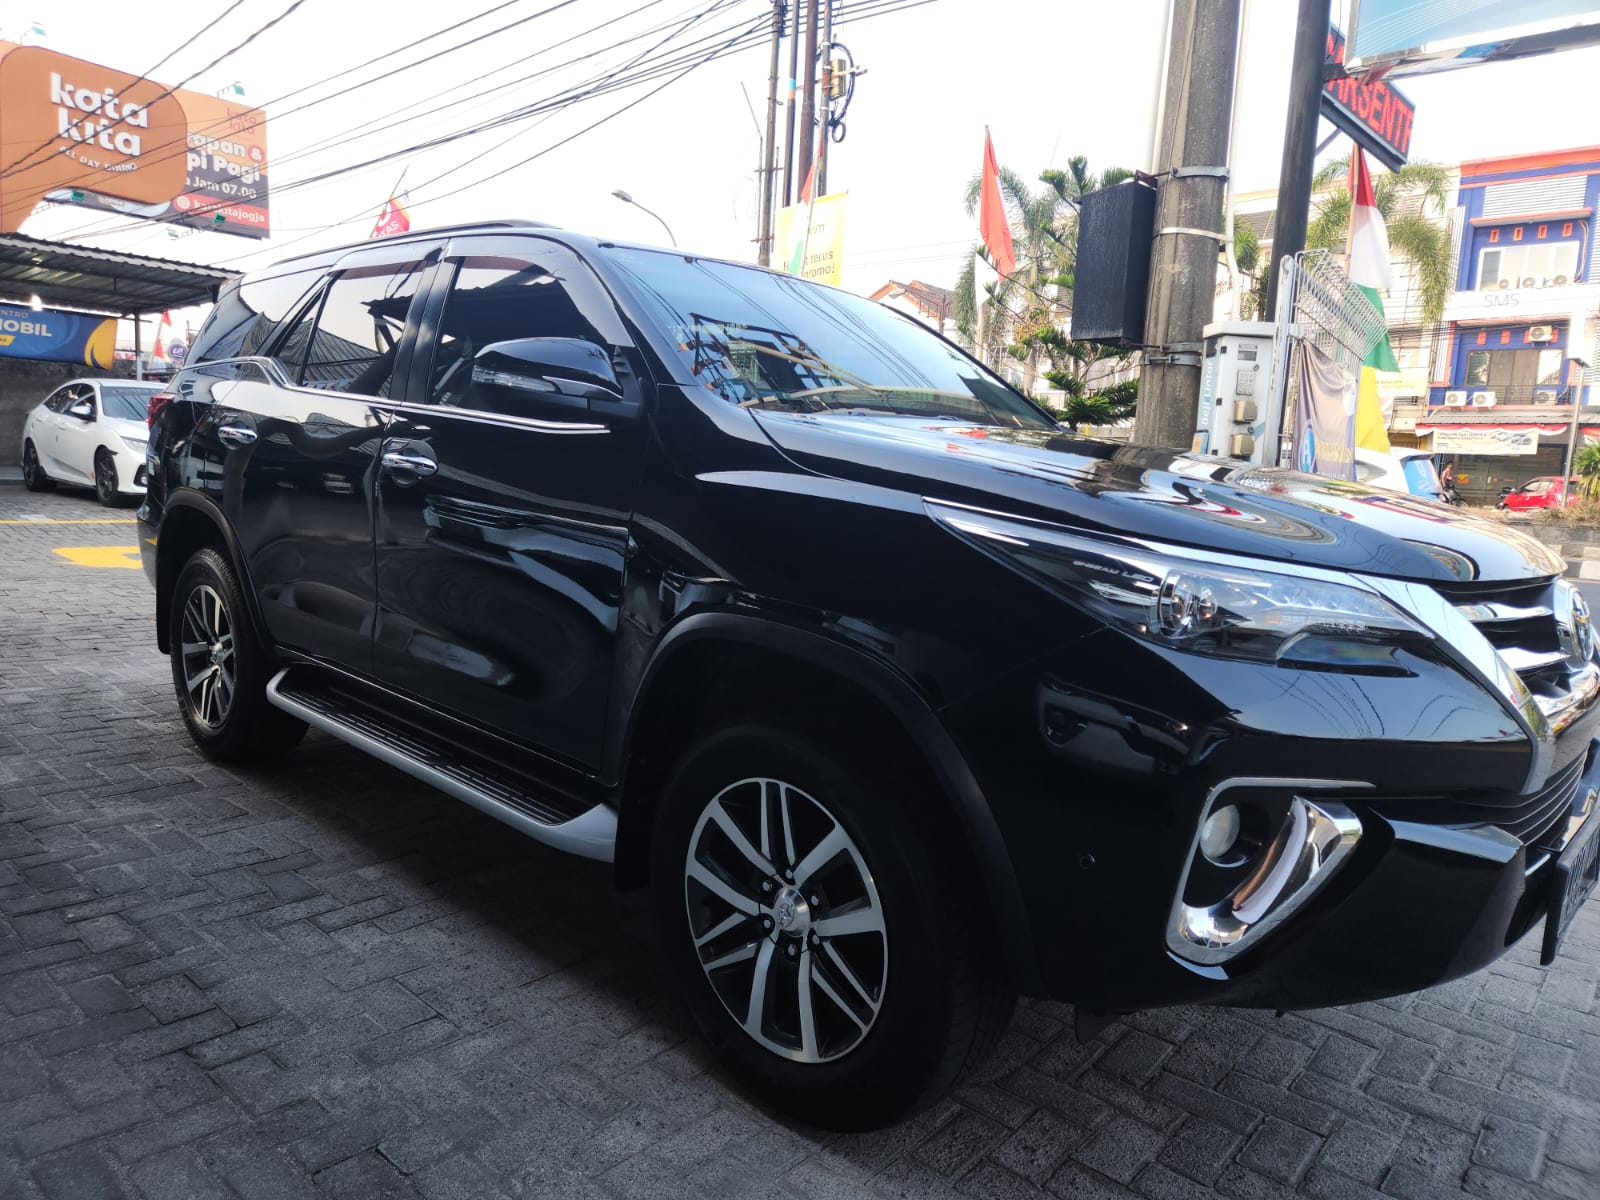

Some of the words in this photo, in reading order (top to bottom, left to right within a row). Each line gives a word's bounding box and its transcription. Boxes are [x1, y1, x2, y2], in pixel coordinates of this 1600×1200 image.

[50, 72, 147, 128] kata
[59, 107, 141, 156] kita
[80, 156, 101, 168] DAY
[212, 155, 261, 185] Pagi
[810, 250, 834, 264] terus
[1483, 293, 1520, 308] SMS
